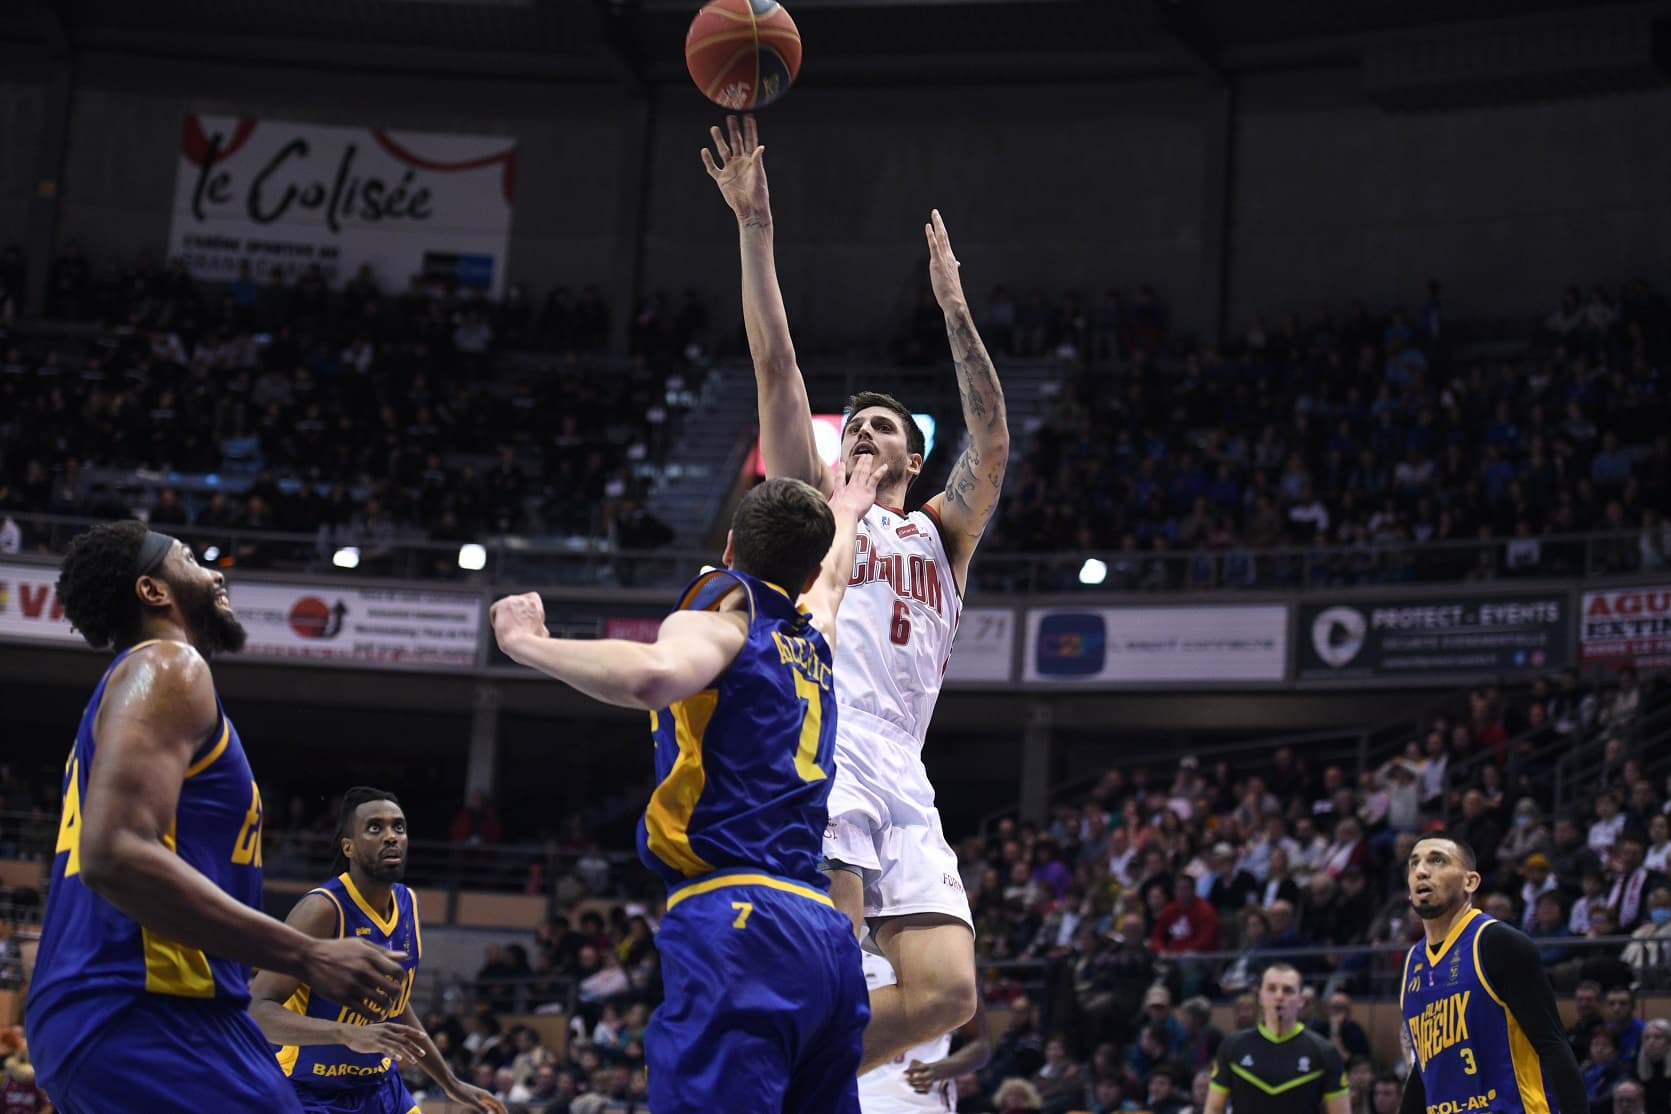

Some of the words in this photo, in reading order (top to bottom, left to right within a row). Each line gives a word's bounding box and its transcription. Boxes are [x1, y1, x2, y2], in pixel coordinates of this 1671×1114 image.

[247, 138, 433, 233] Colisée
[889, 600, 912, 646] 6
[1371, 605, 1464, 629] PROTECT
[1478, 601, 1561, 625] EVENTS
[792, 666, 828, 783] 7
[731, 901, 754, 929] 7
[1408, 991, 1471, 1073] EVREUX
[1460, 1047, 1478, 1075] 3
